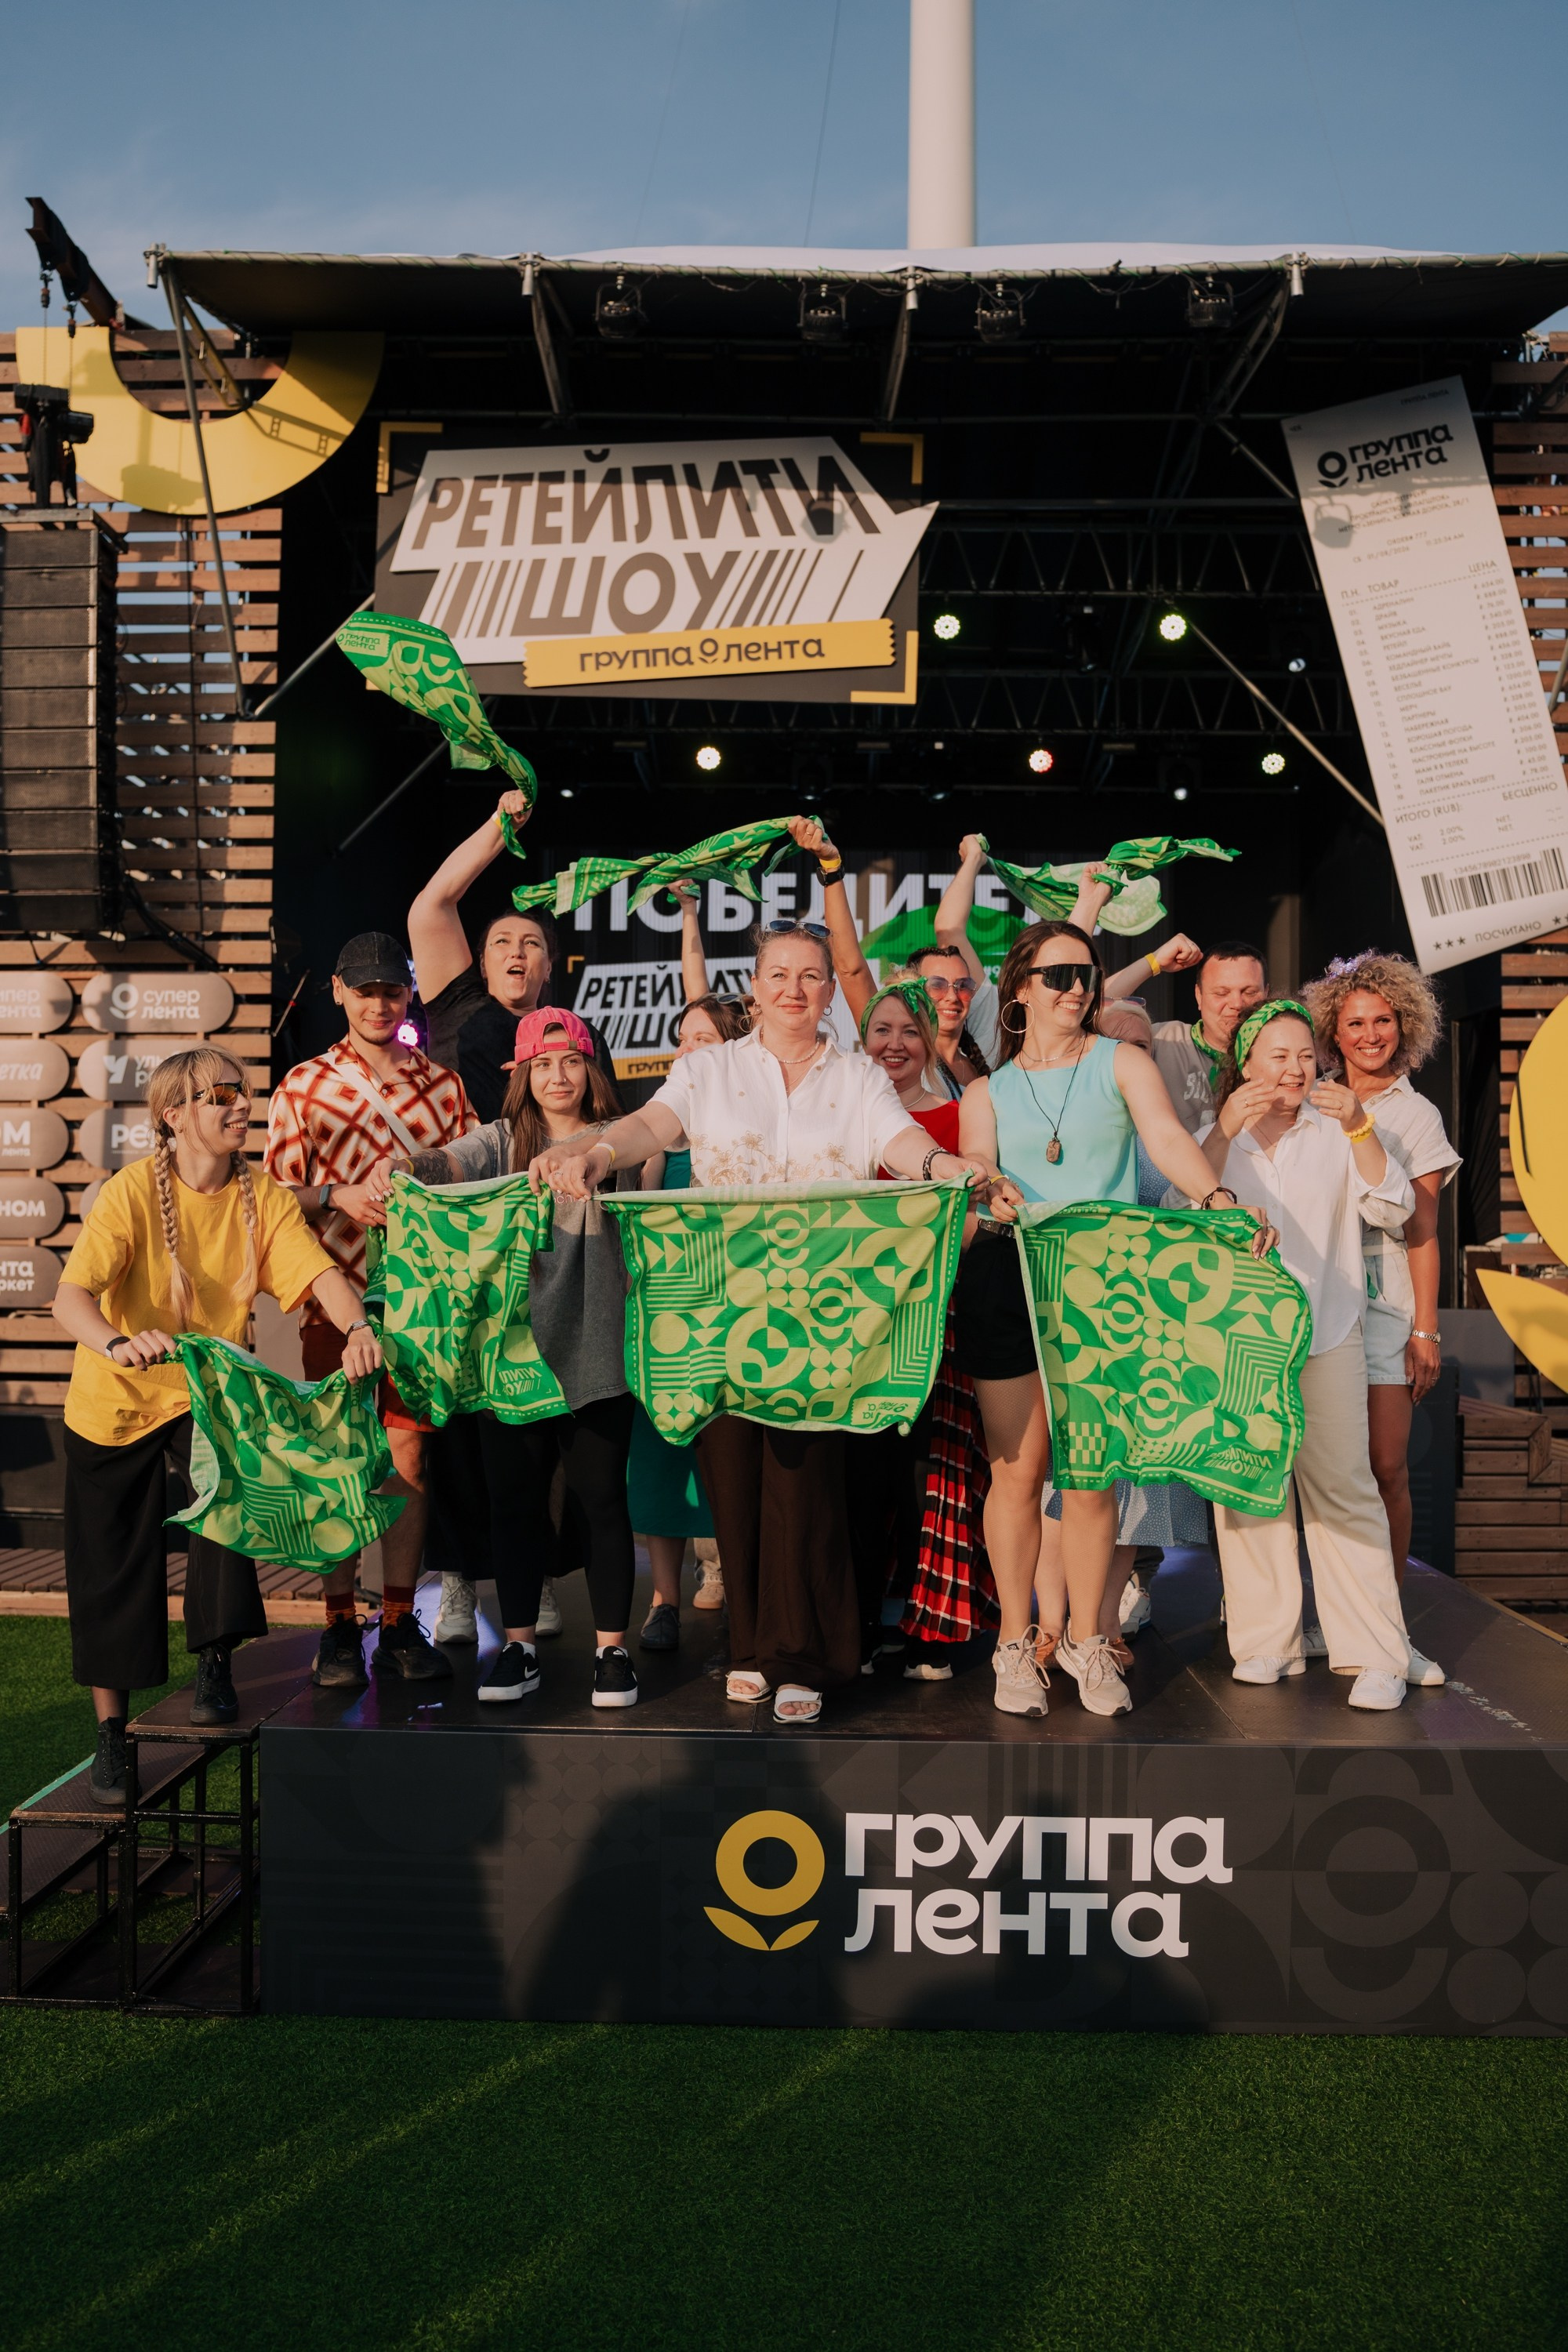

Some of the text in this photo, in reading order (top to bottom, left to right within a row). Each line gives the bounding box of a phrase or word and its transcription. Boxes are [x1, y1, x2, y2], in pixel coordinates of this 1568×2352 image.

[1348, 424, 1454, 463] группа
[1353, 445, 1448, 482] лента
[412, 447, 882, 550] РЕТЕЙЛИТИ
[510, 550, 743, 637] ШОУ
[1367, 579, 1399, 593] ТОВАР
[1468, 559, 1497, 573] ЦЕНА
[579, 637, 825, 673] группа лента
[1395, 809, 1431, 824] ИТОГО
[1502, 781, 1558, 801] БЕСЦЕННО
[1474, 920, 1541, 942] ПОСЧИТАНО
[141, 1005, 201, 1020] лента
[143, 989, 201, 1007] супер
[843, 1811, 1235, 1885] группа
[843, 1886, 1190, 1958] лента
